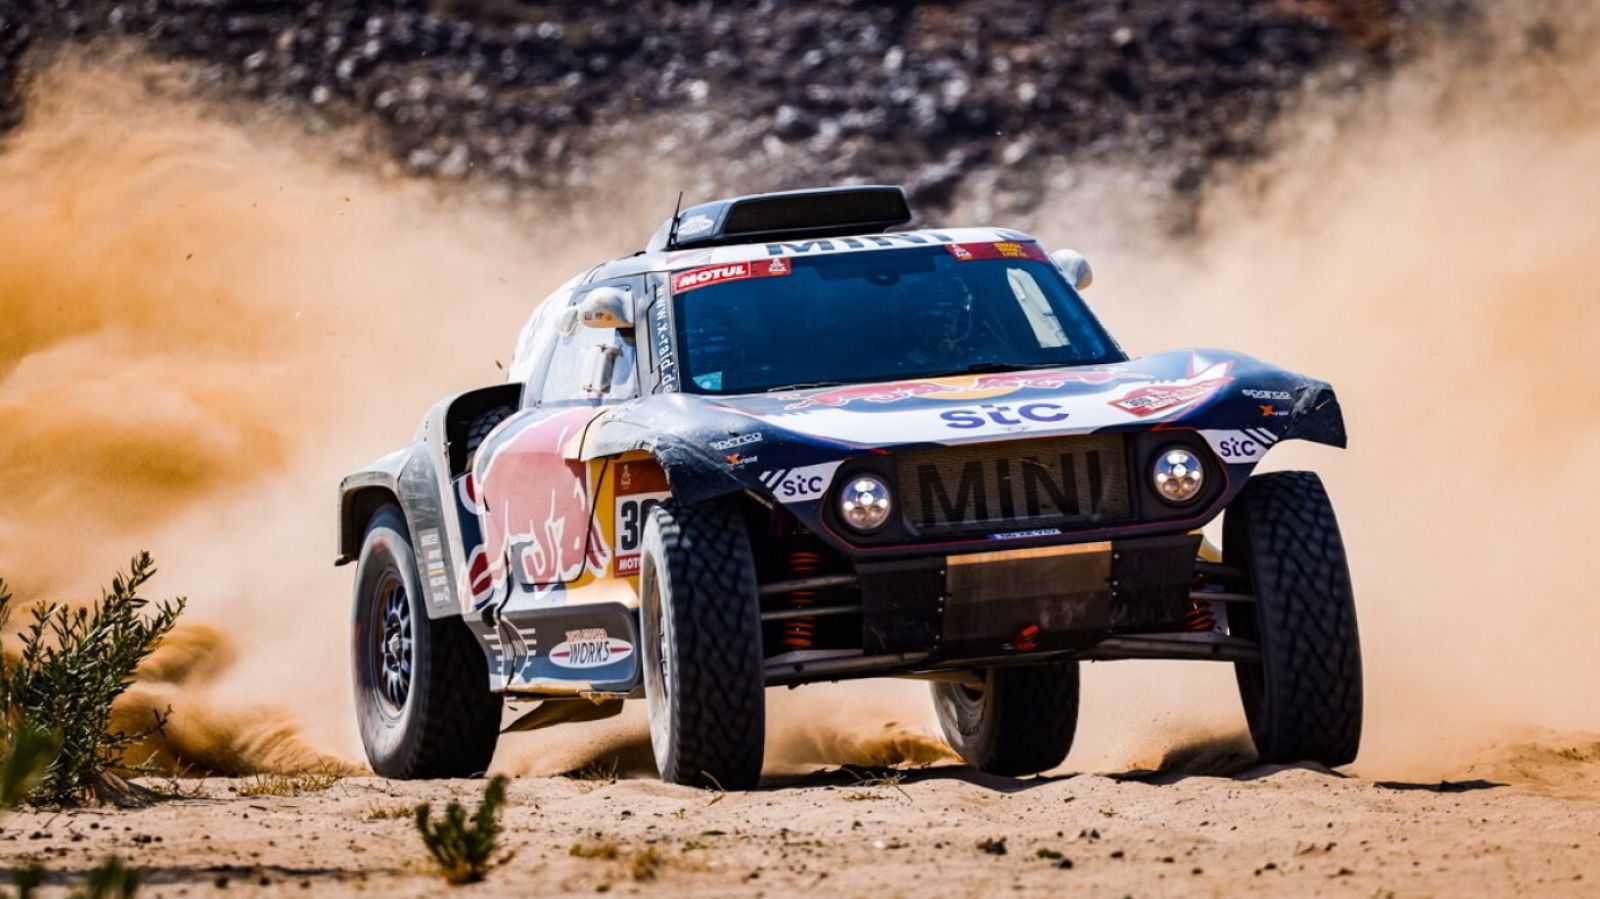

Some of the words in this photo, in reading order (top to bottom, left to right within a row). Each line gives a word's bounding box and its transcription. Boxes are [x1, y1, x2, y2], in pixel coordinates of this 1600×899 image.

[679, 265, 746, 288] MOTUL
[1242, 388, 1292, 400] sparco
[939, 403, 1070, 429] stc
[709, 432, 763, 450] sparco
[1219, 437, 1257, 457] stc
[782, 474, 823, 497] stc
[917, 451, 1104, 528] MINI
[569, 641, 610, 665] WORKS
